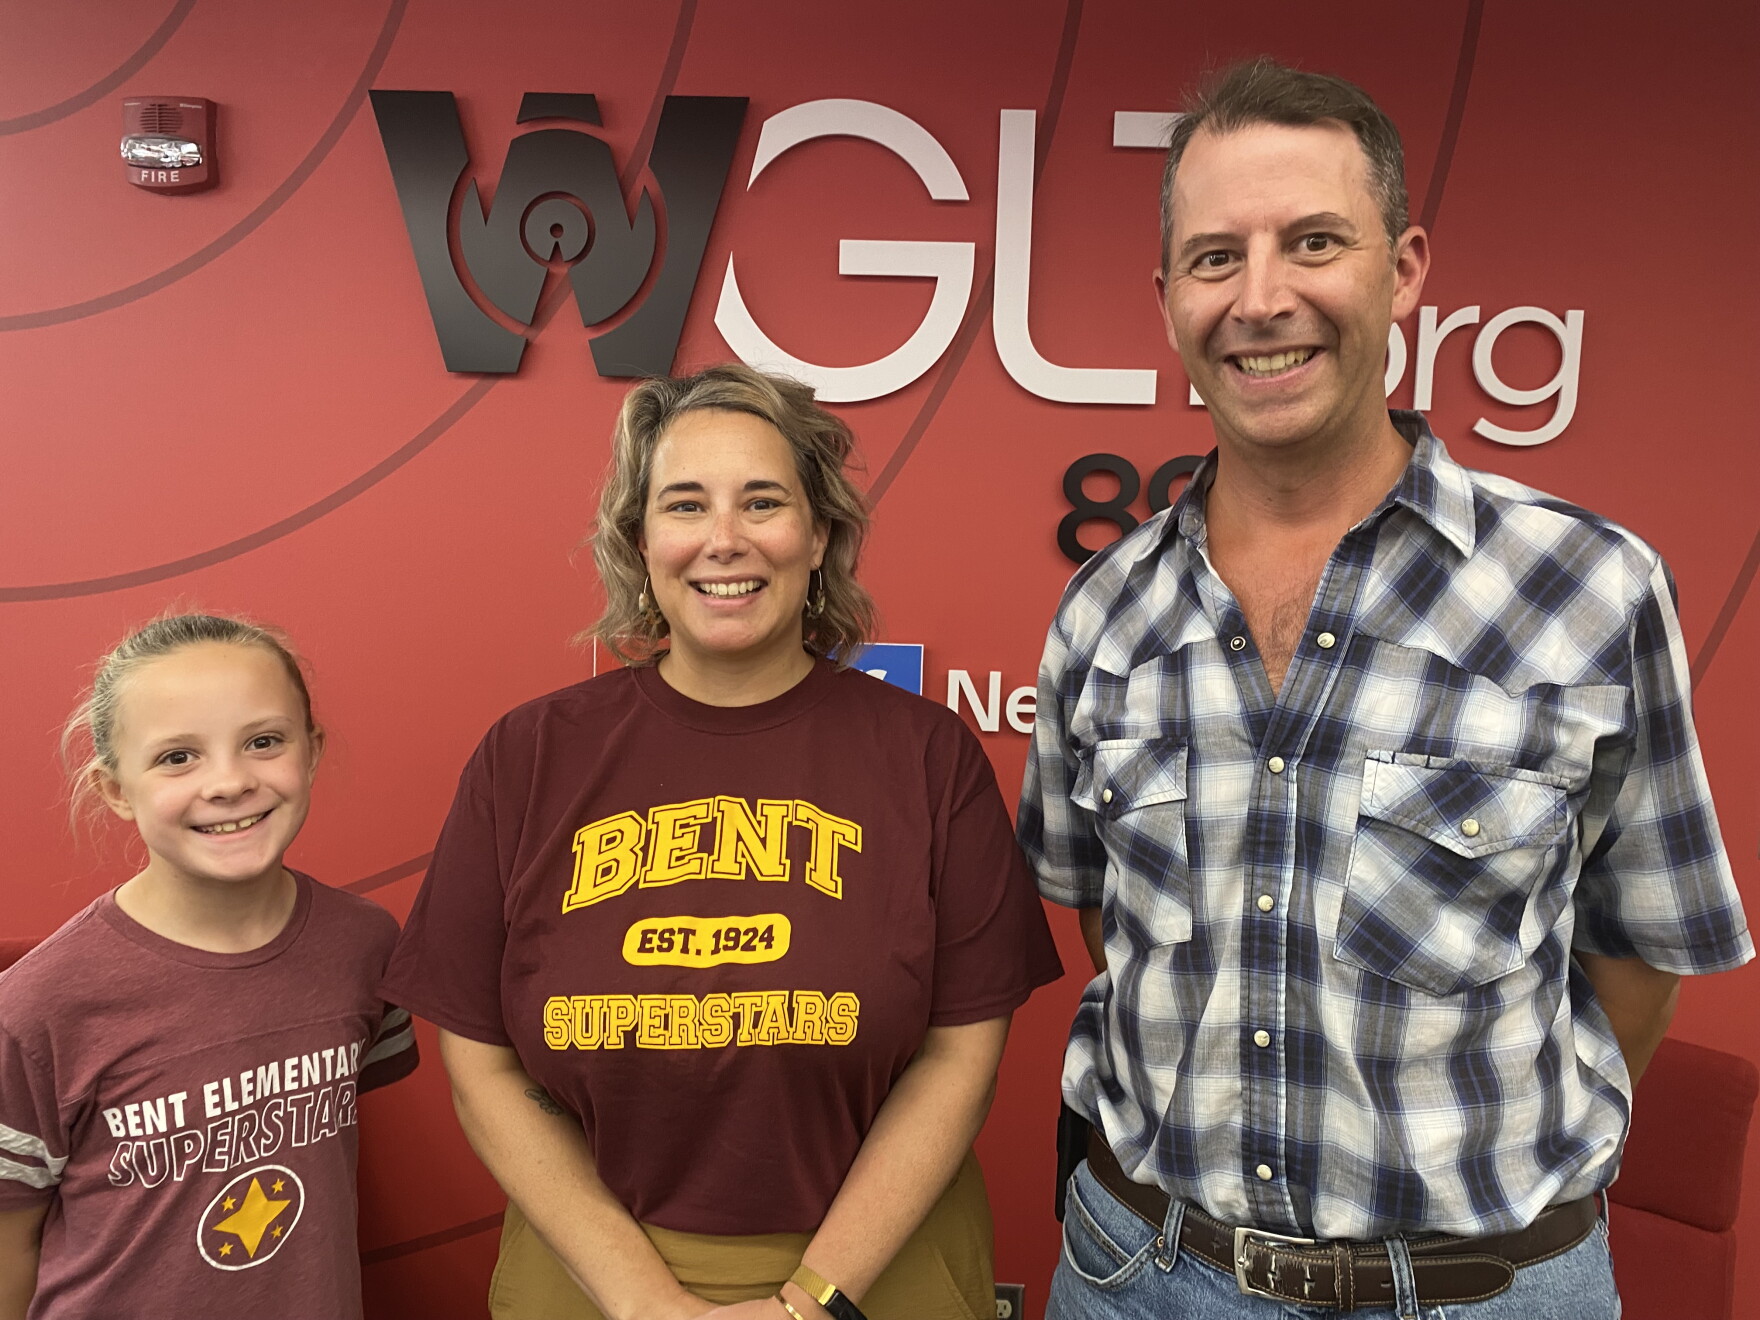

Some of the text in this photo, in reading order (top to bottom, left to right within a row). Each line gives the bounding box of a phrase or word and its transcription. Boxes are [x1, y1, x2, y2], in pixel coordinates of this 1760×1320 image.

[140, 169, 180, 183] FIRE
[561, 795, 862, 915] BENT
[636, 924, 775, 957] EST. 1924
[543, 990, 860, 1051] SUPERSTARS
[102, 1091, 188, 1138] BENT
[107, 1081, 358, 1189] SUPERSTAR
